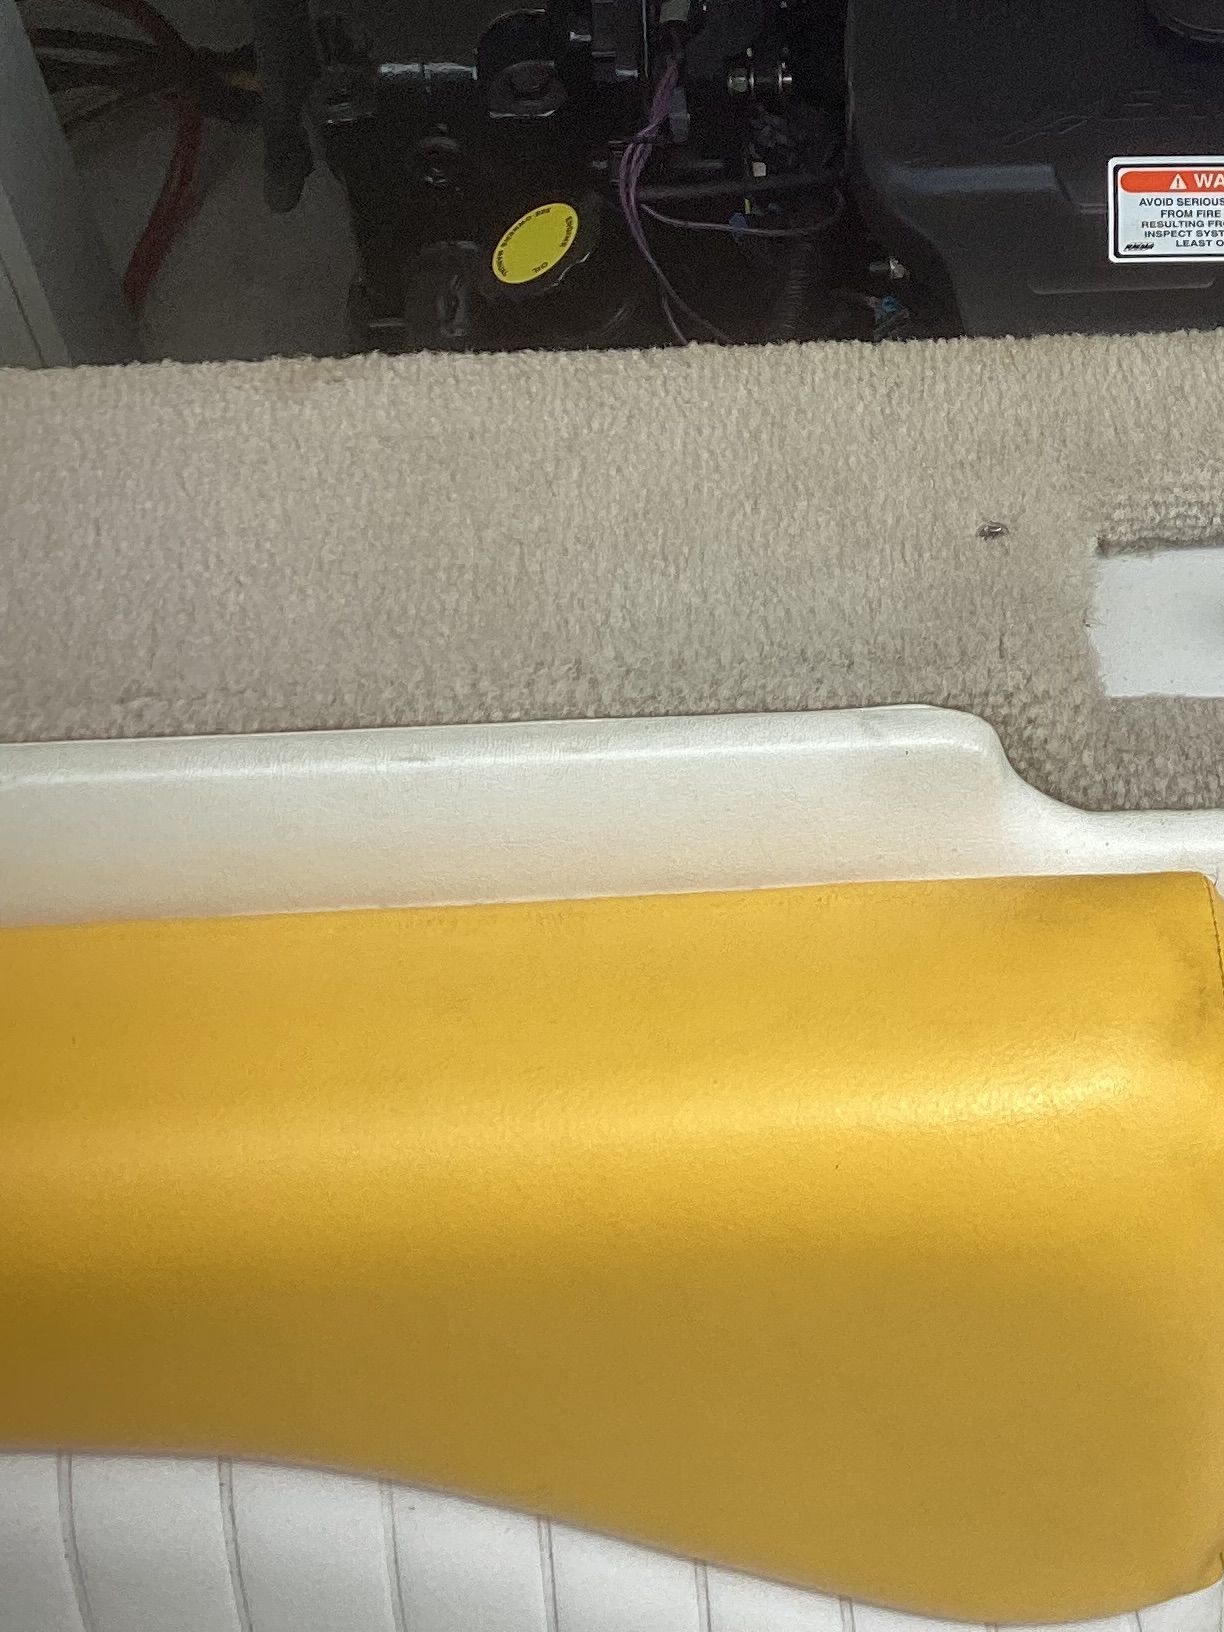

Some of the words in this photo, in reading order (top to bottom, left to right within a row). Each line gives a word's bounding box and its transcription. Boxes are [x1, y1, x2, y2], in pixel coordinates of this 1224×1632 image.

[1139, 197, 1174, 207] AVOID
[1160, 209, 1193, 218] FROM
[1196, 209, 1222, 218] FIRE
[1141, 220, 1205, 229] RESULTING
[1144, 229, 1193, 238] INSPECT
[1175, 239, 1213, 248] LEAST
